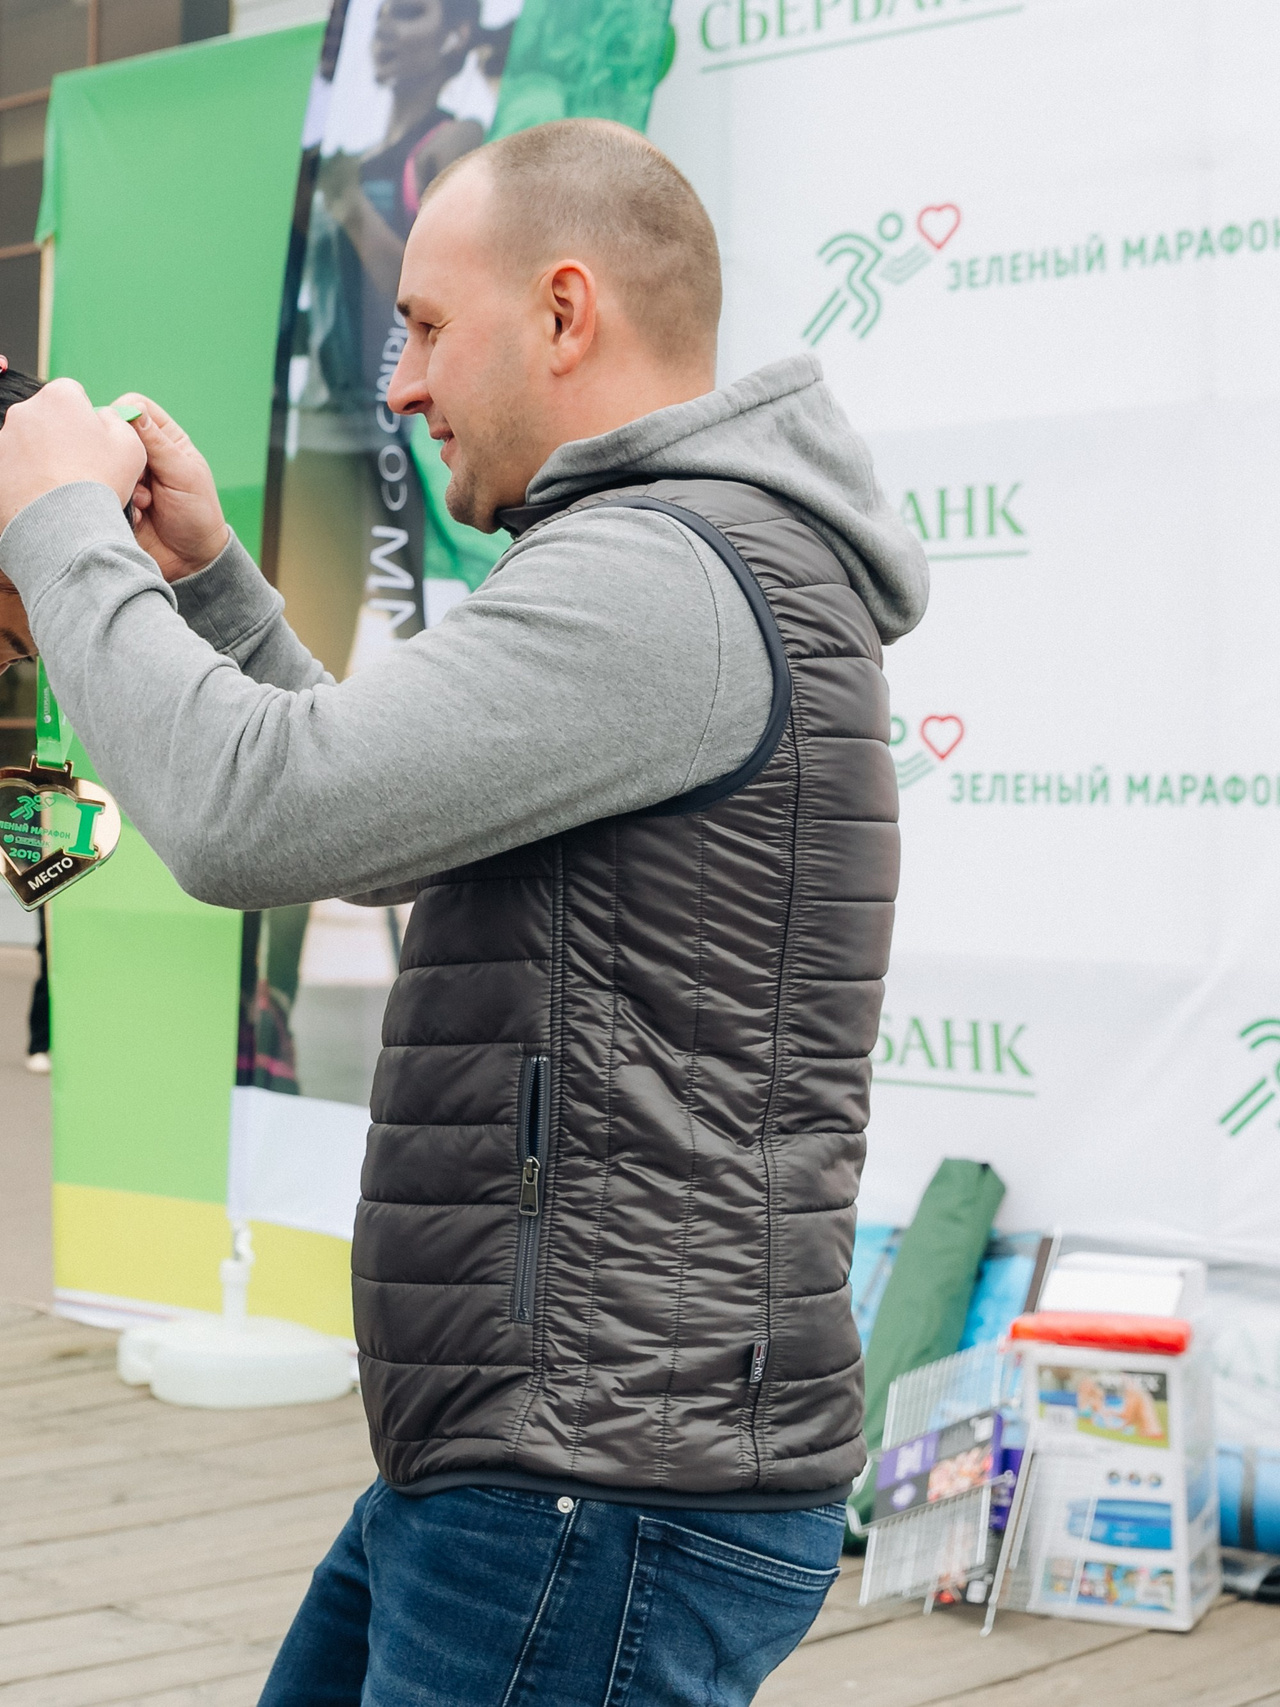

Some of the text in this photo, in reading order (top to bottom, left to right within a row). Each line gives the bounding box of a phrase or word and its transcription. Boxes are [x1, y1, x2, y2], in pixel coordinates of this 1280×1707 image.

[946, 235, 1107, 293] ЗЕЛЕНЫЙ
[949, 766, 1280, 807] ЗЕЛЕНЫЙ МАРАФО
[30, 826, 71, 840] МАРАФОН
[9, 847, 41, 863] 2019
[27, 856, 74, 891] МЕСТО
